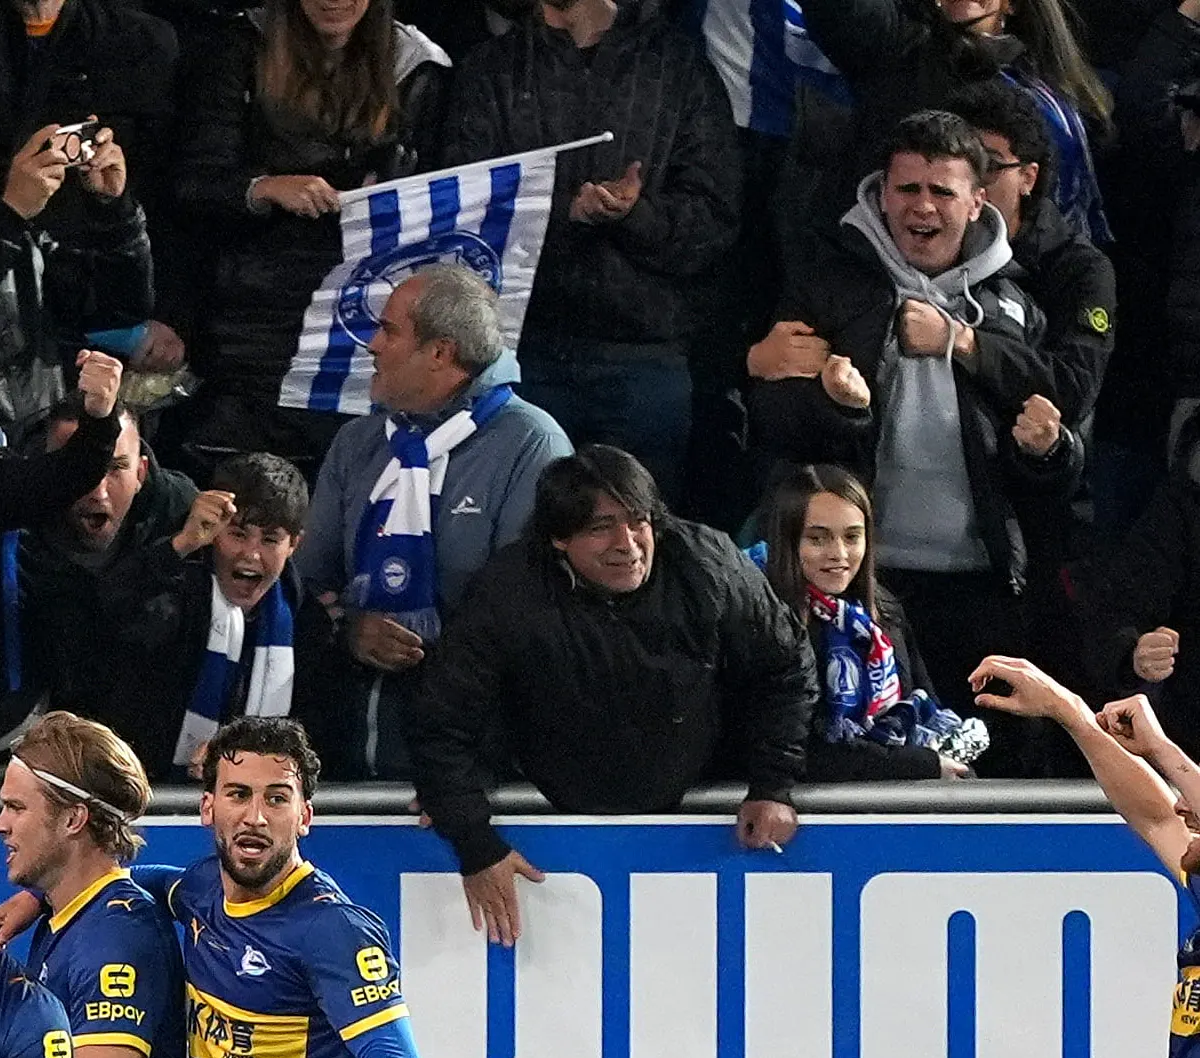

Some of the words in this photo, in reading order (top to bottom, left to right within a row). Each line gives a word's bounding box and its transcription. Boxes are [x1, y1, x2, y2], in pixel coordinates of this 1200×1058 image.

[351, 979, 401, 1006] EBpa
[85, 1001, 145, 1026] EBpay
[188, 999, 255, 1054] K体育
